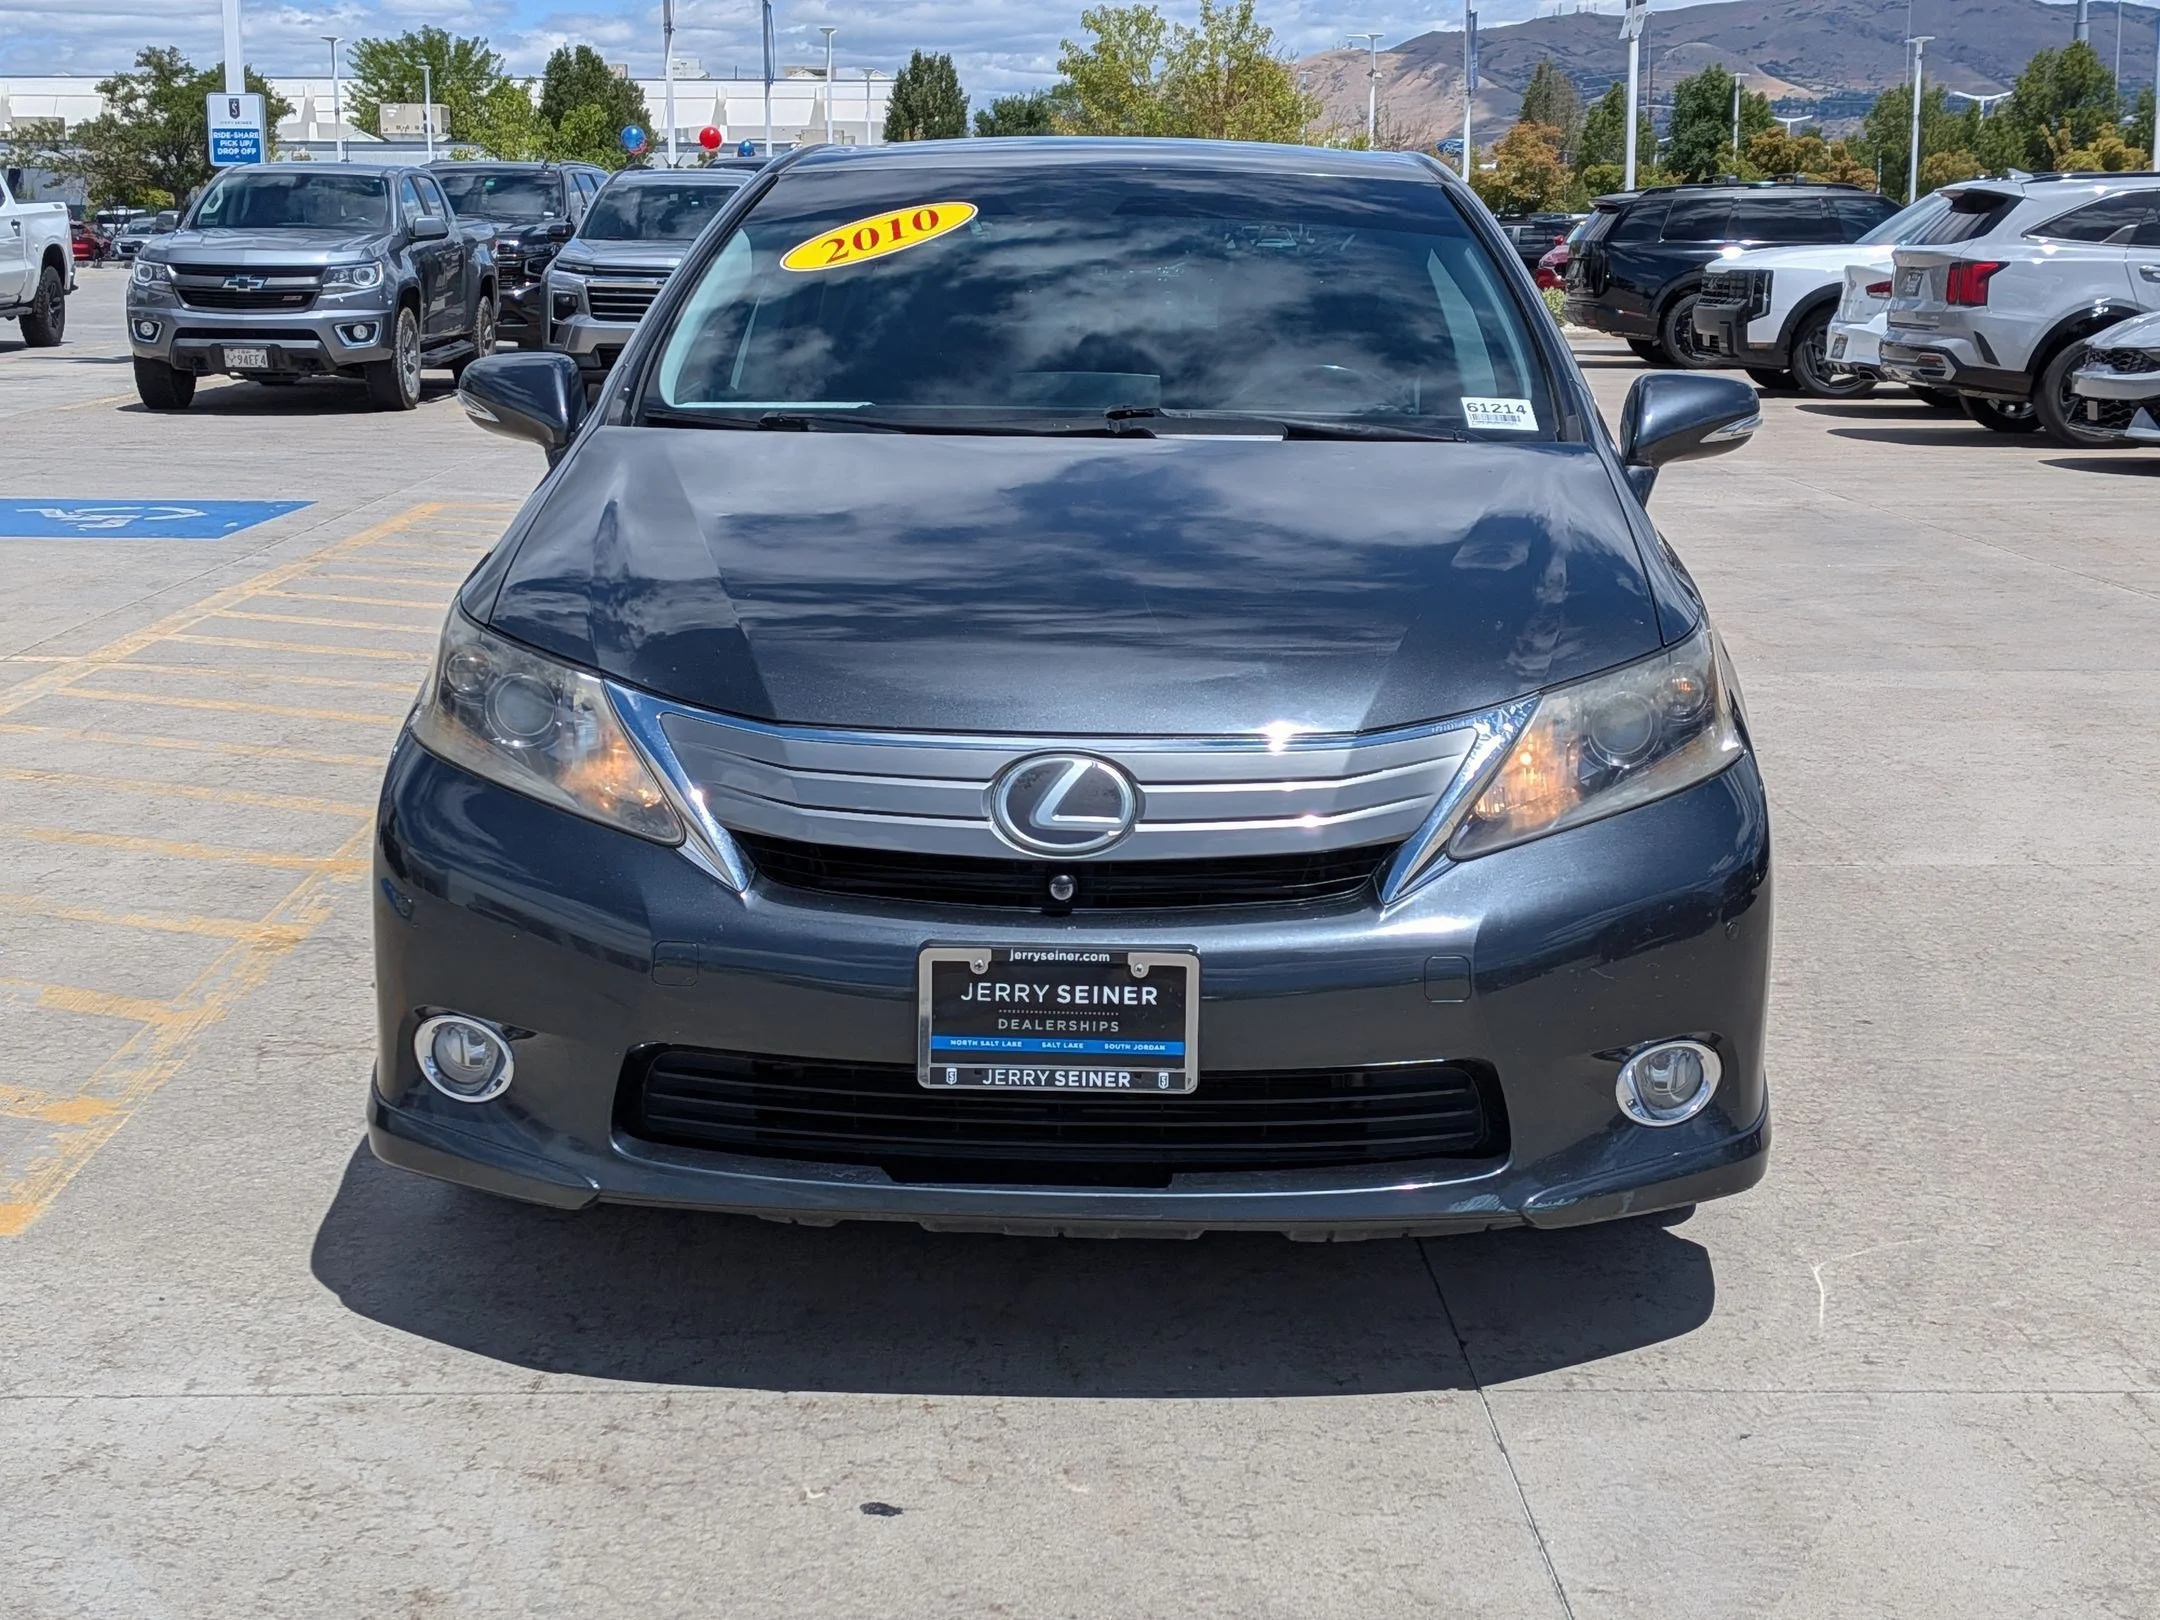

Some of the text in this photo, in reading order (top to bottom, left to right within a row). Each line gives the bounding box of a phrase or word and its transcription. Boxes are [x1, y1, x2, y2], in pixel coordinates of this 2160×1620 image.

[213, 131, 259, 139] RIDE-SHARE
[240, 139, 254, 148] UP/
[820, 209, 940, 265] 2010
[1466, 402, 1527, 415] 61214
[1009, 949, 1110, 963] jerryseiner.com
[960, 982, 1158, 1006] JERRY SEINER
[998, 1018, 1119, 1032] DEALERSHIPS
[950, 1039, 978, 1047] NORTH
[1041, 1041, 1061, 1049] SALT
[982, 1069, 1131, 1088] JERRY SEINER
